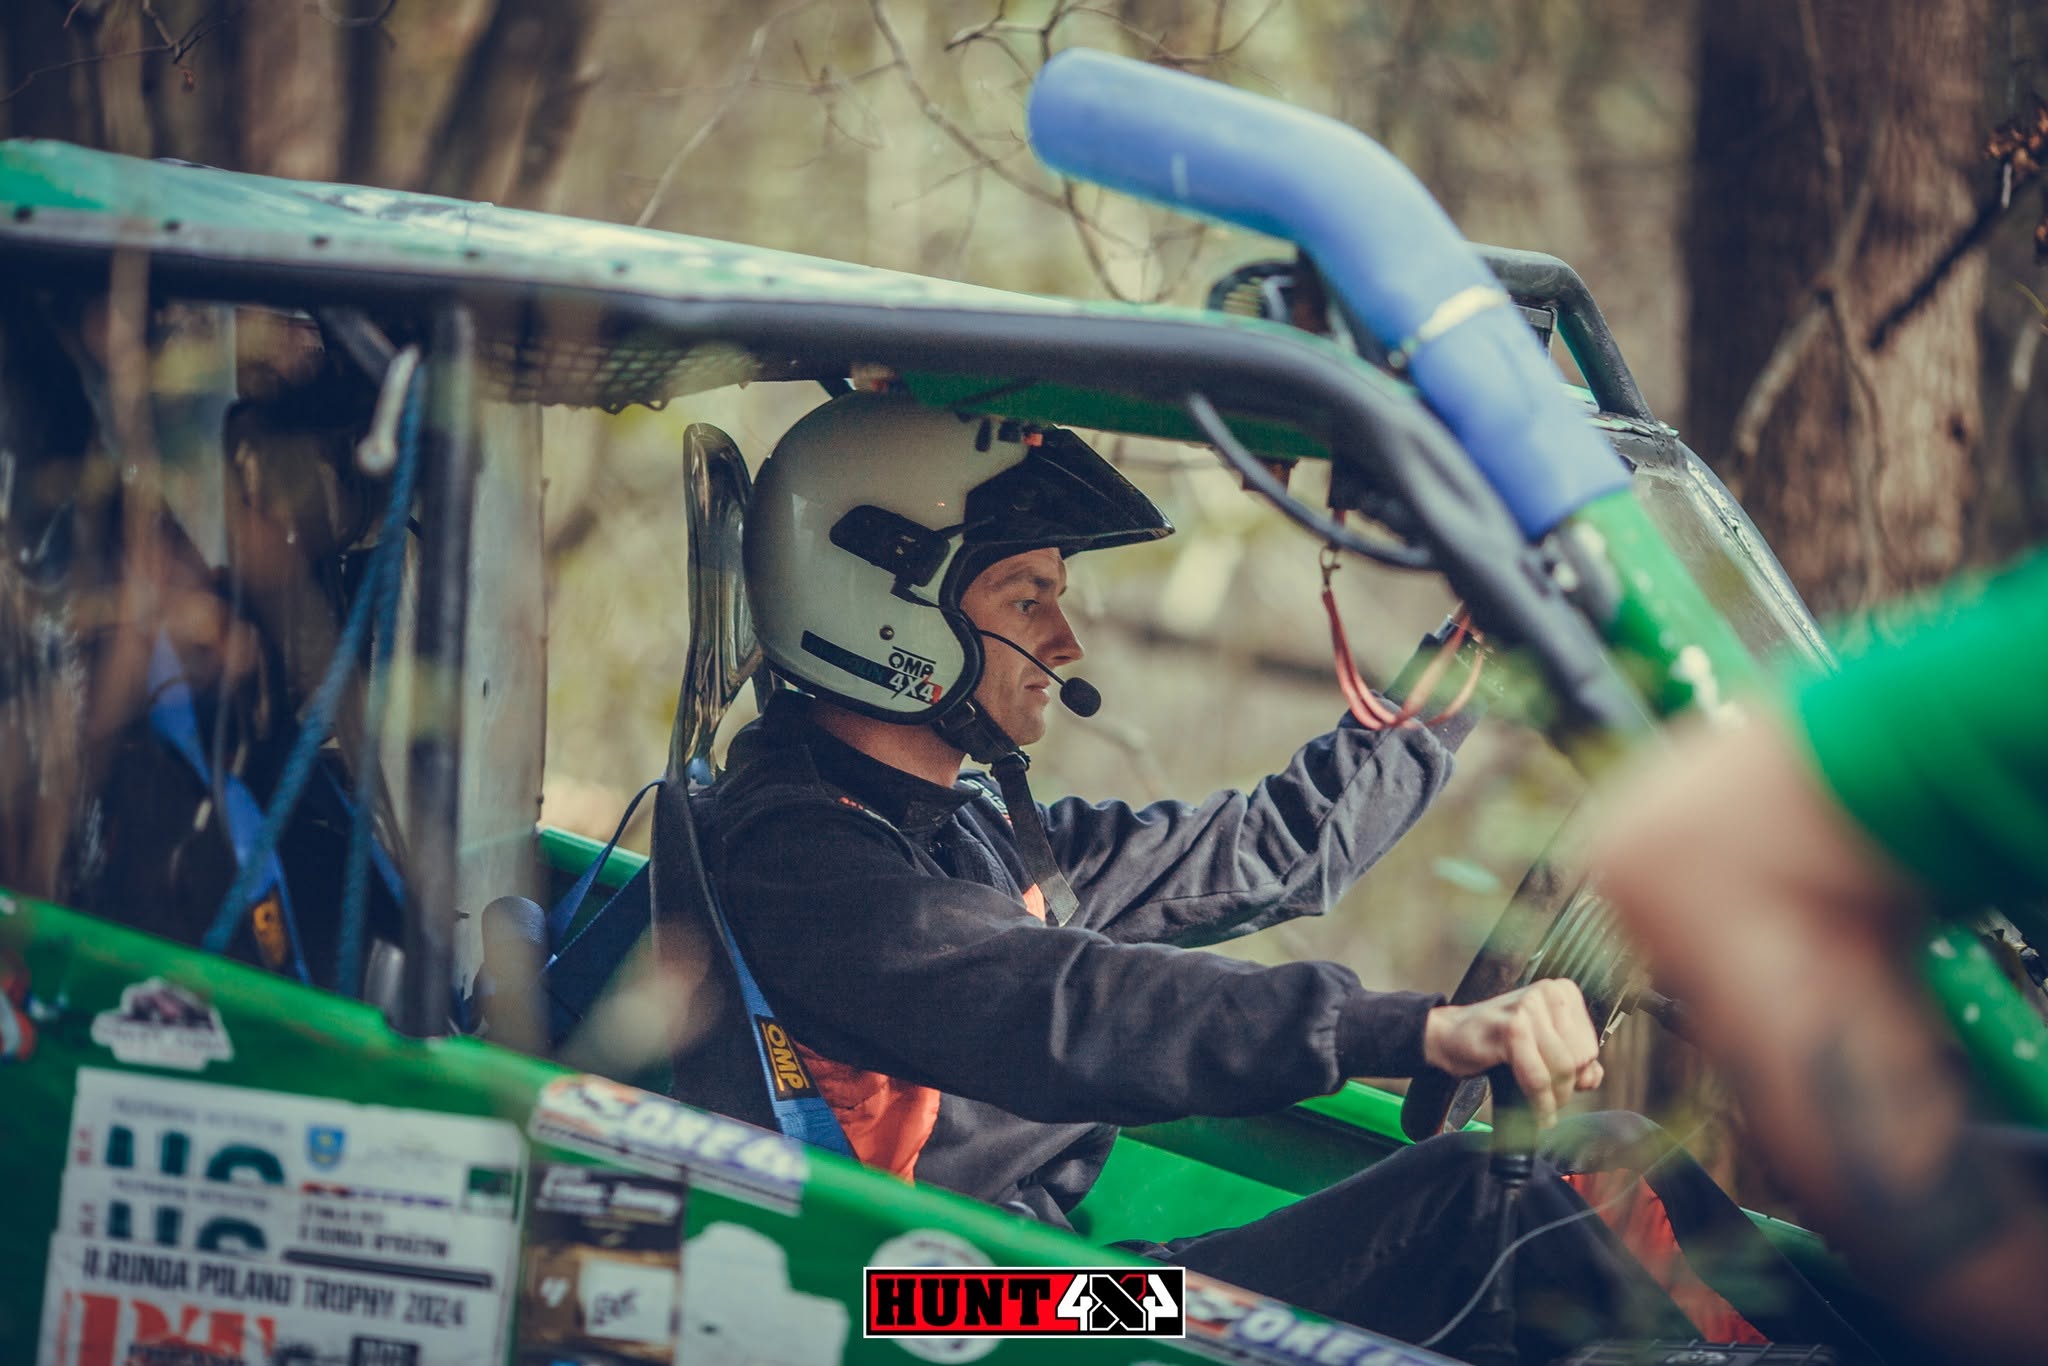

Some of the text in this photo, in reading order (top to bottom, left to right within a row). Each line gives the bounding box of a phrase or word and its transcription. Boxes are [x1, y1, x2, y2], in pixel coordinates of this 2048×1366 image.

[888, 651, 934, 678] OMP
[767, 1023, 804, 1089] OMP
[105, 1250, 188, 1289] RUNDA
[198, 1261, 291, 1307] POLAND
[303, 1276, 396, 1318] TROPHY
[403, 1290, 464, 1328] 2024
